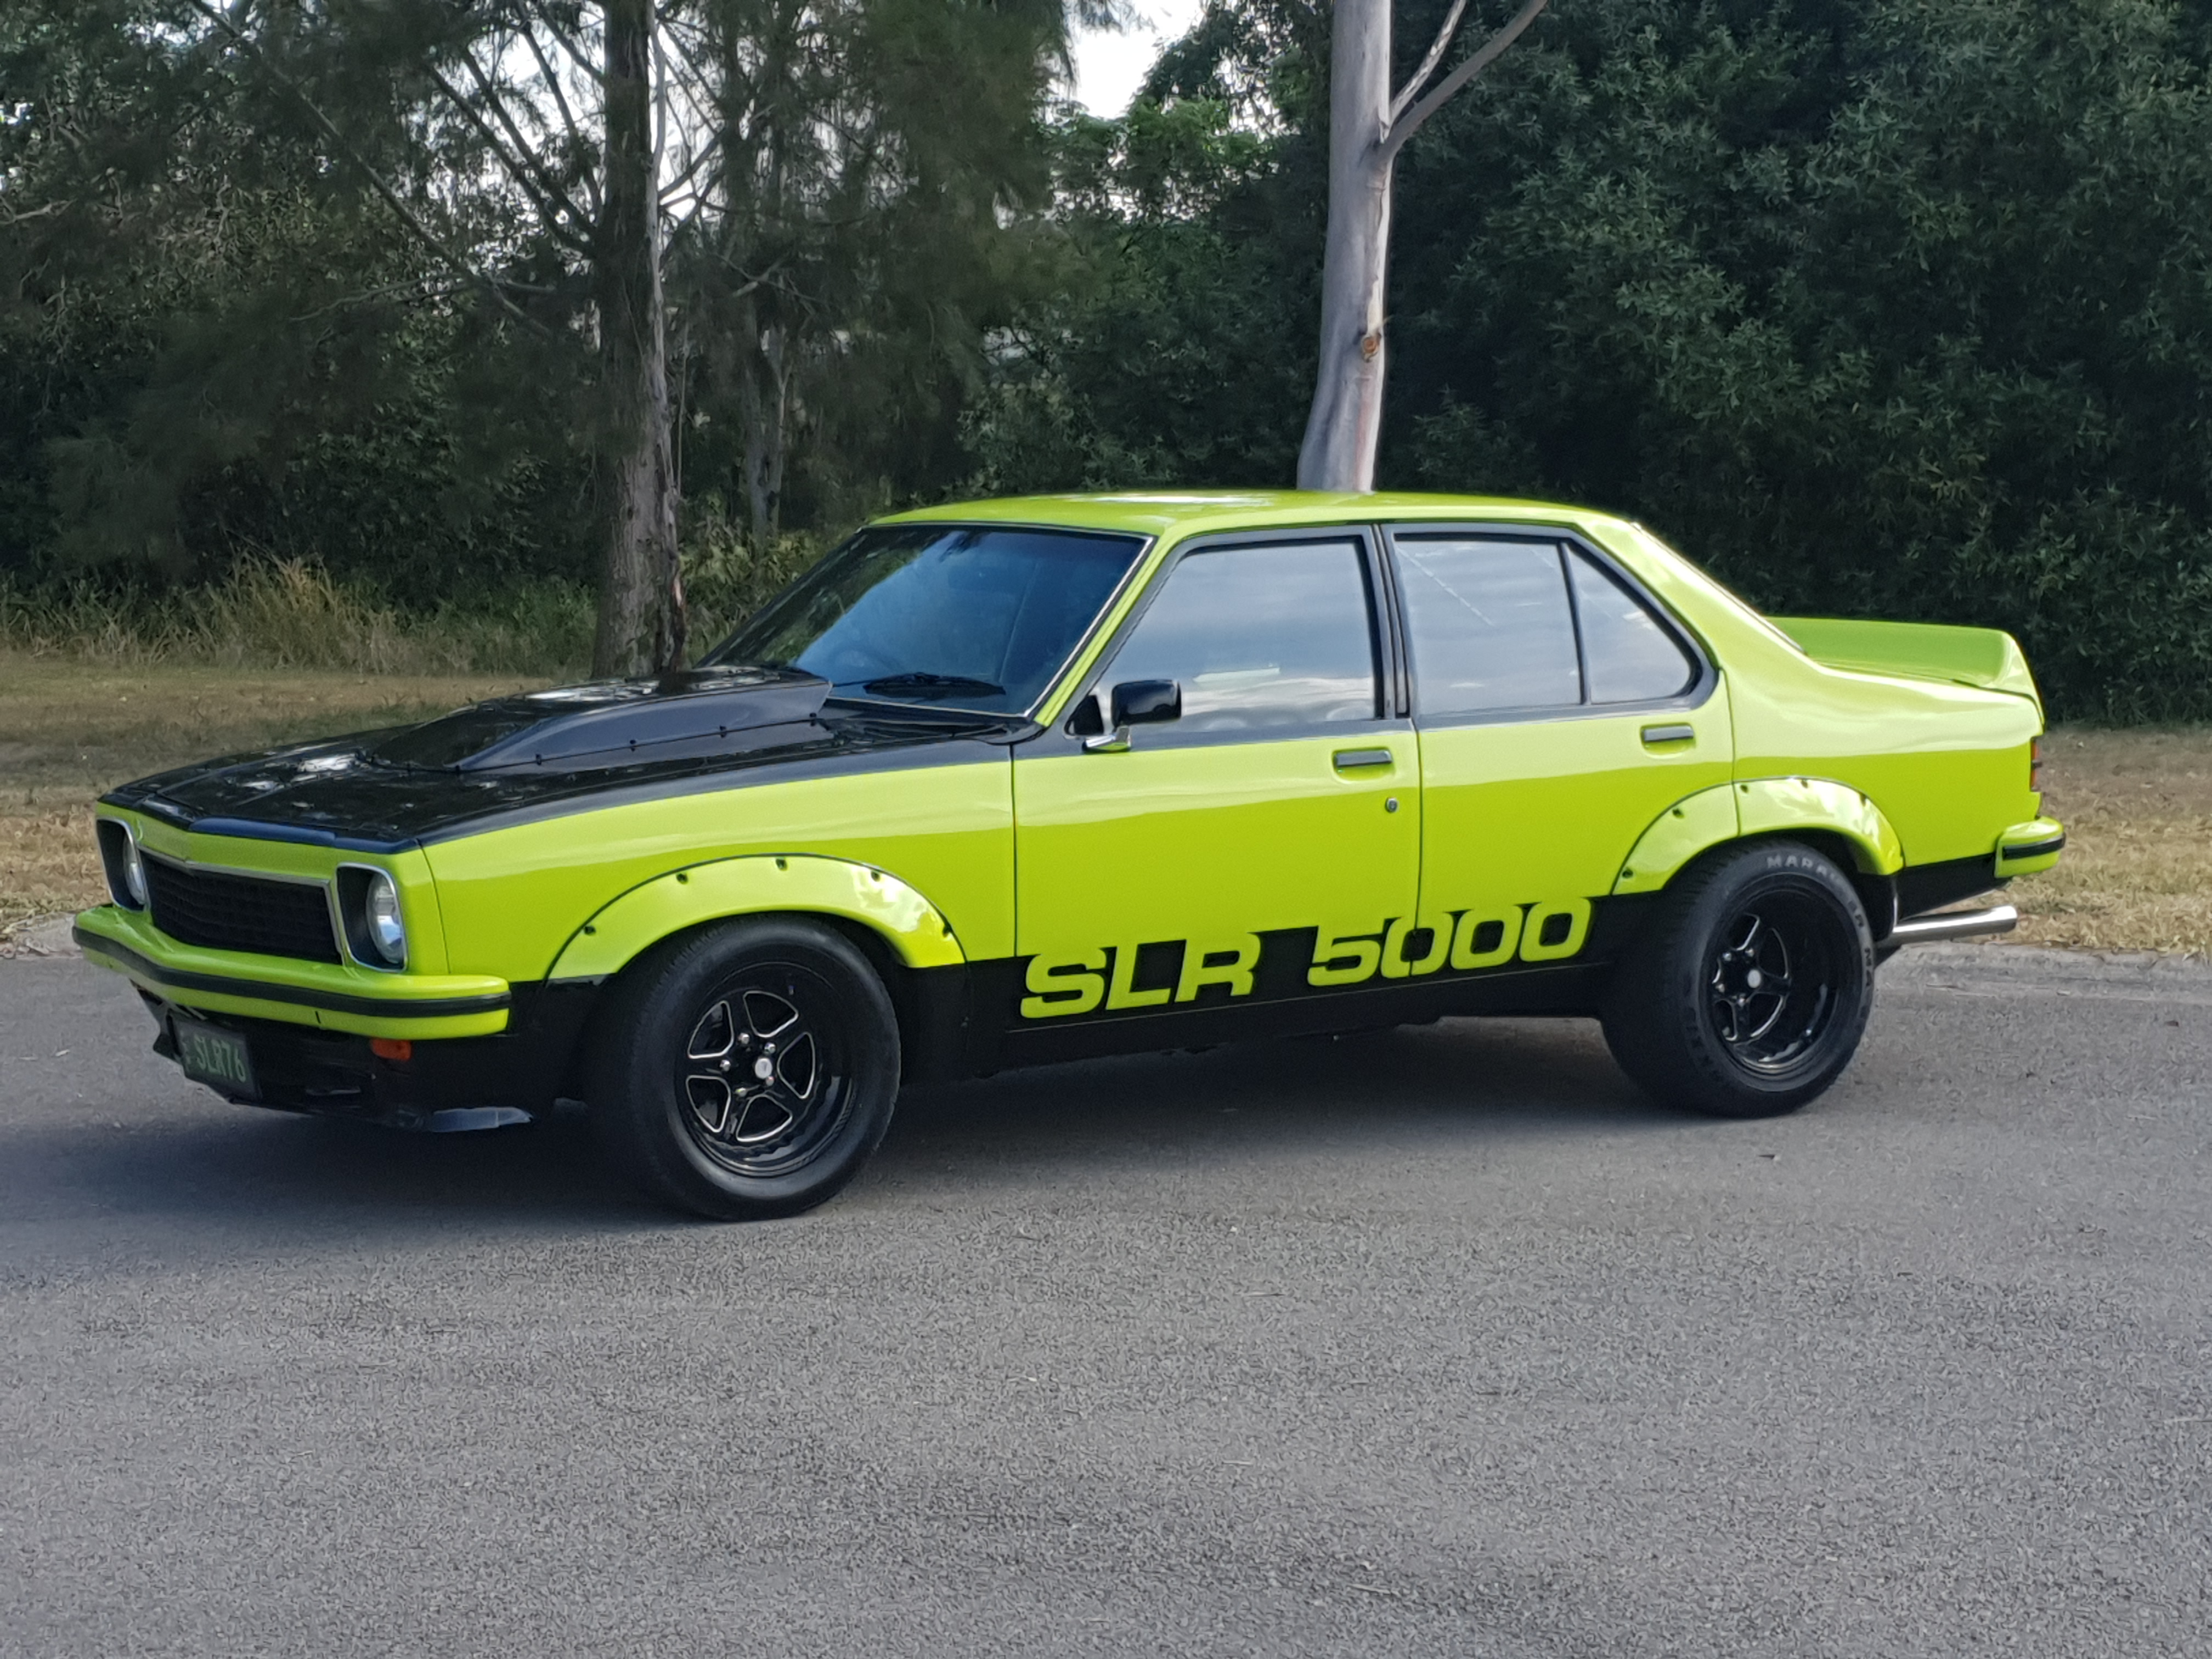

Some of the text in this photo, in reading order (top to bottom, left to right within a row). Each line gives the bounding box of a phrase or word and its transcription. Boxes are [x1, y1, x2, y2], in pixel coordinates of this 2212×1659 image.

[1020, 896, 1592, 1019] SLR 5000
[194, 1034, 246, 1083] SLR76
